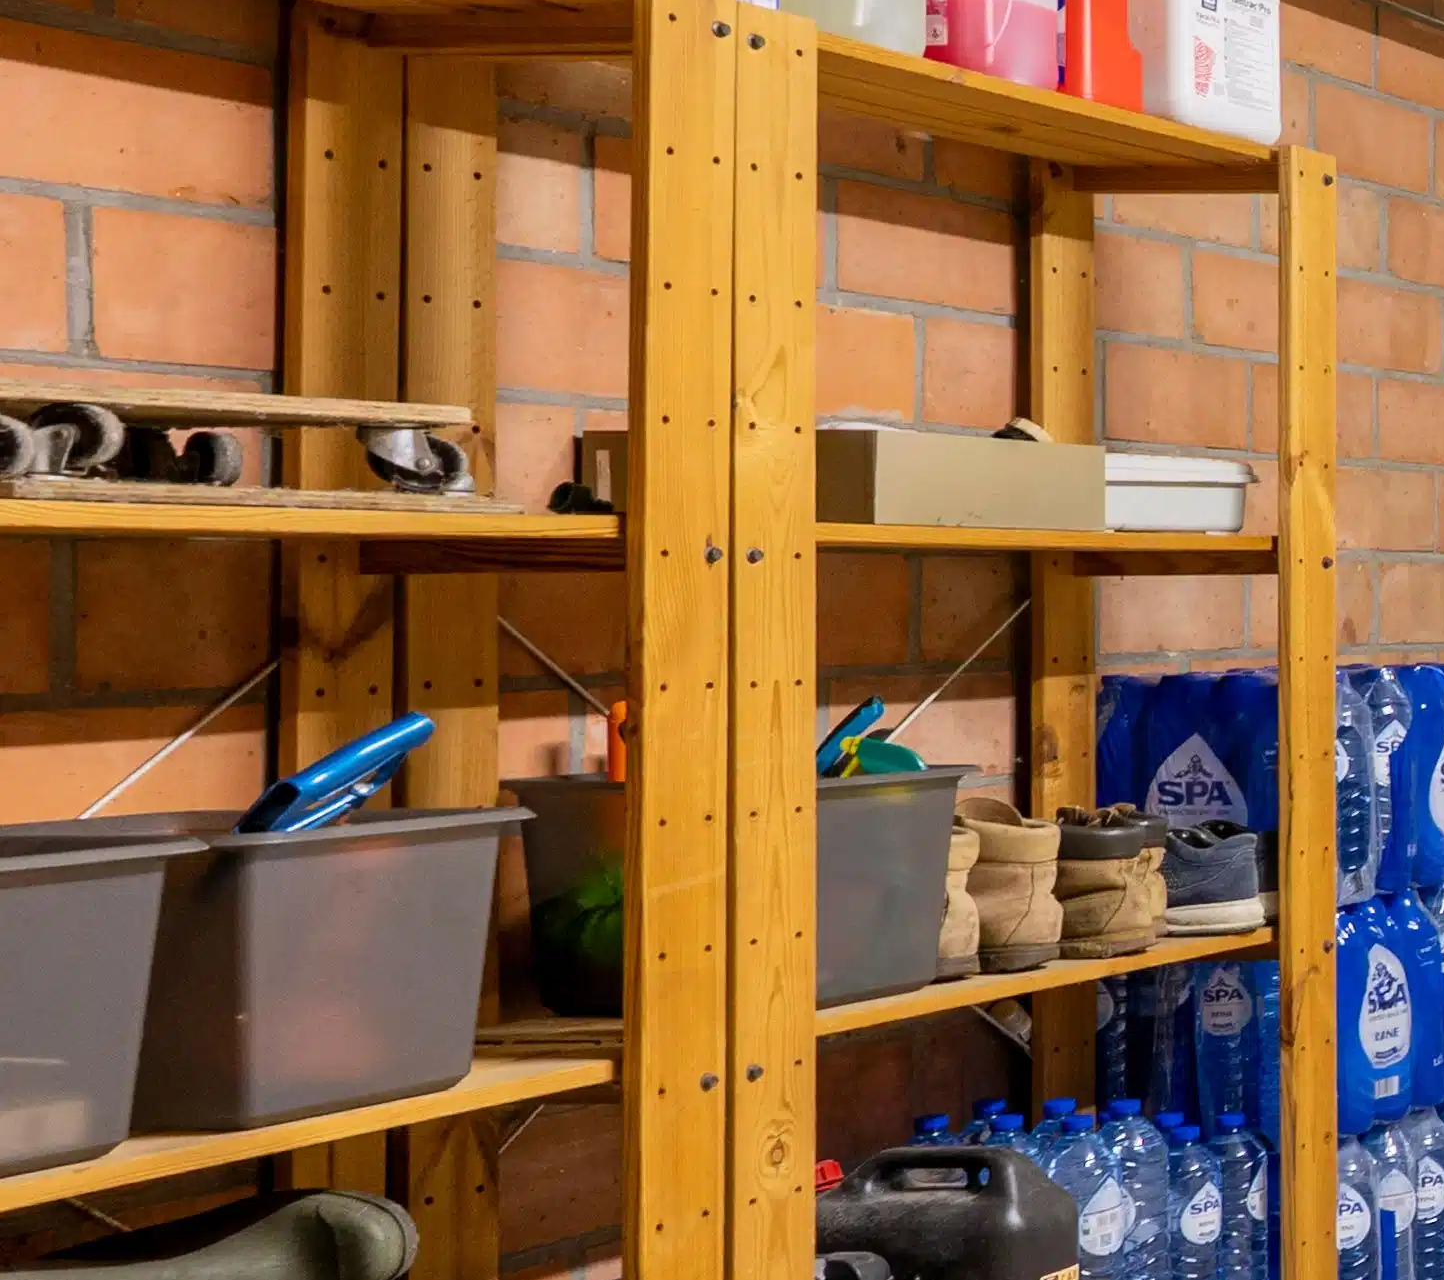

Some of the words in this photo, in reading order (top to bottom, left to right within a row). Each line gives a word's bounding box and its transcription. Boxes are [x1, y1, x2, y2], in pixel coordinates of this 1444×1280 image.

[1376, 739, 1400, 753] SP
[1158, 781, 1232, 806] SPA
[1203, 988, 1243, 1003] SPA
[1421, 1175, 1444, 1188] PA
[1190, 1198, 1221, 1215] SPA
[1339, 1203, 1364, 1216] PA
